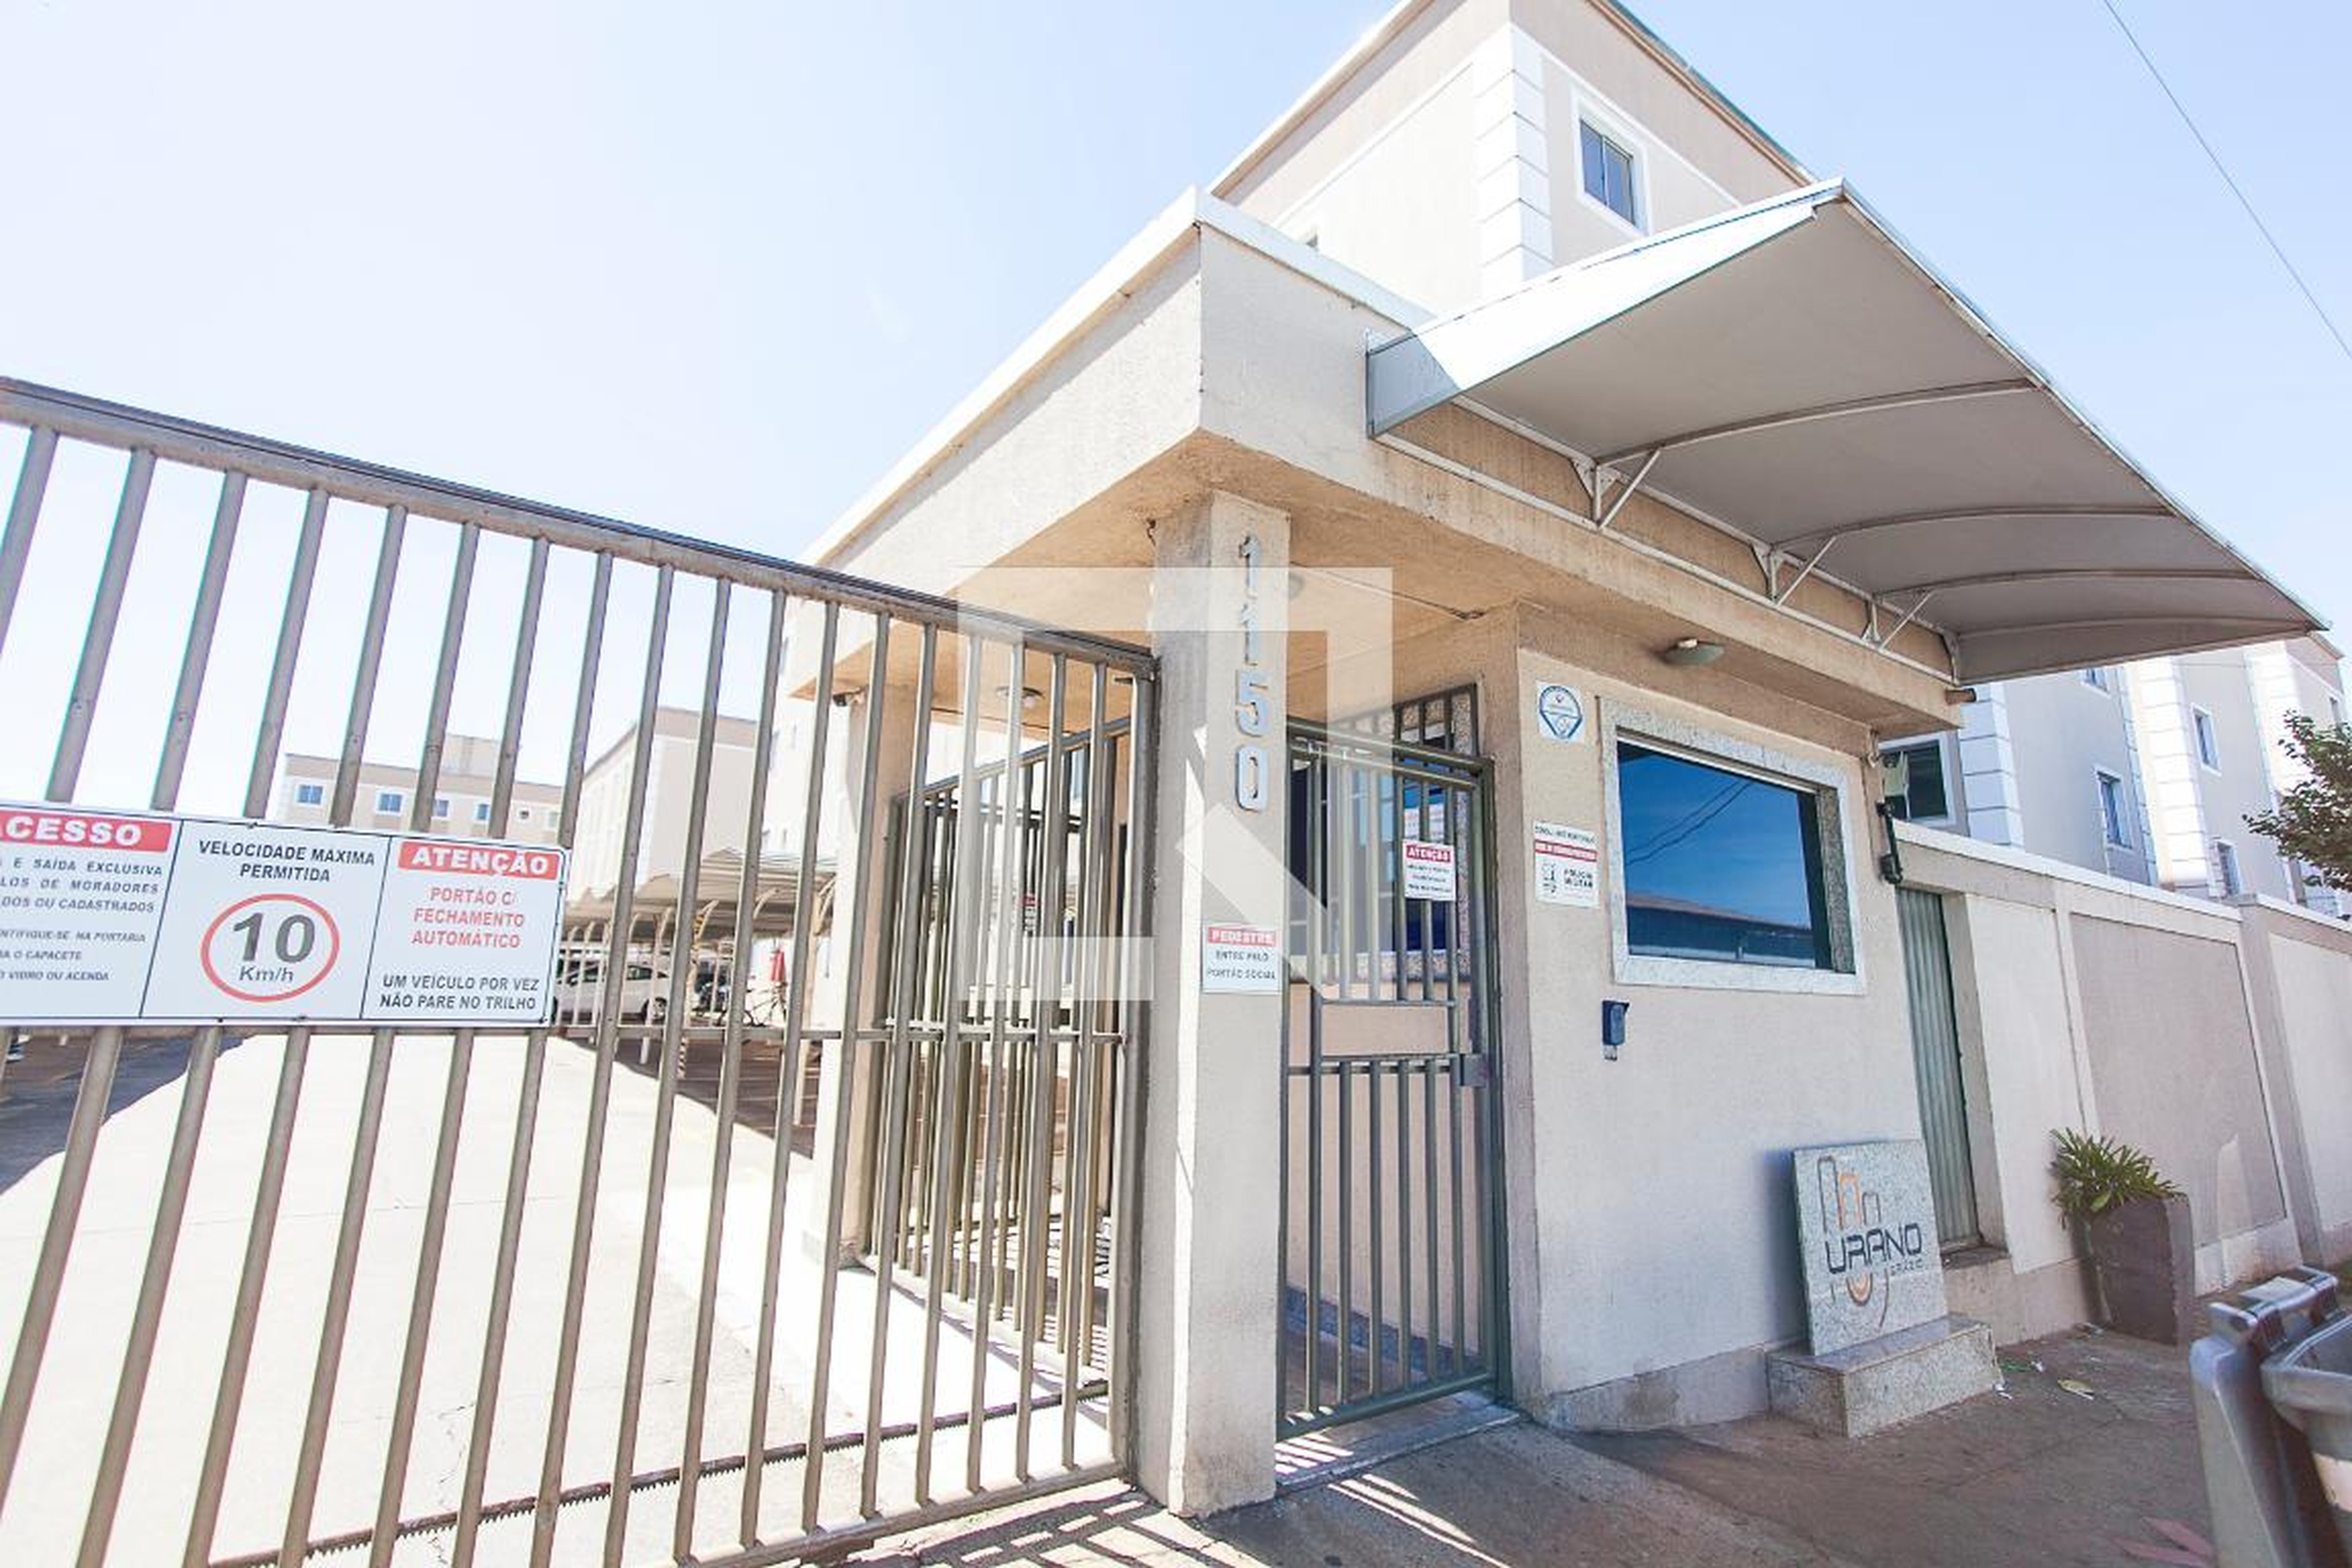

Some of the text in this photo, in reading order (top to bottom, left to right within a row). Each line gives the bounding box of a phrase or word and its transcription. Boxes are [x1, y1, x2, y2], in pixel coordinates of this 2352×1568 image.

[1235, 533, 1270, 812] 1150
[0, 815, 142, 846] CESSO
[199, 840, 306, 860] VELOCIDADE
[13, 857, 163, 875] E SAÍDA EXCLUSIVA
[412, 847, 548, 875] ATENÇÃO
[240, 863, 330, 882] PERMITIDA
[40, 878, 60, 889] DE
[70, 879, 159, 894] MORADORES
[430, 886, 497, 905] PORTÃO
[34, 897, 55, 908] OU
[58, 897, 154, 913] CADASTRADOS
[414, 908, 525, 927] FECHAMENTO
[76, 930, 91, 940] NA
[94, 931, 146, 943] PORTARIA
[233, 912, 315, 963] 10
[412, 927, 521, 948] AUTOMÁTICO
[26, 951, 82, 961] CAPACETE
[46, 971, 63, 981] OU
[65, 971, 109, 981] ACENDA
[239, 965, 294, 982] Km/h
[383, 974, 407, 988] UM
[480, 977, 508, 990] POR
[513, 978, 540, 991] VEZ
[380, 992, 536, 1009] NÃO PARE NO TRILHO
[1825, 1223, 1922, 1274] URANO
